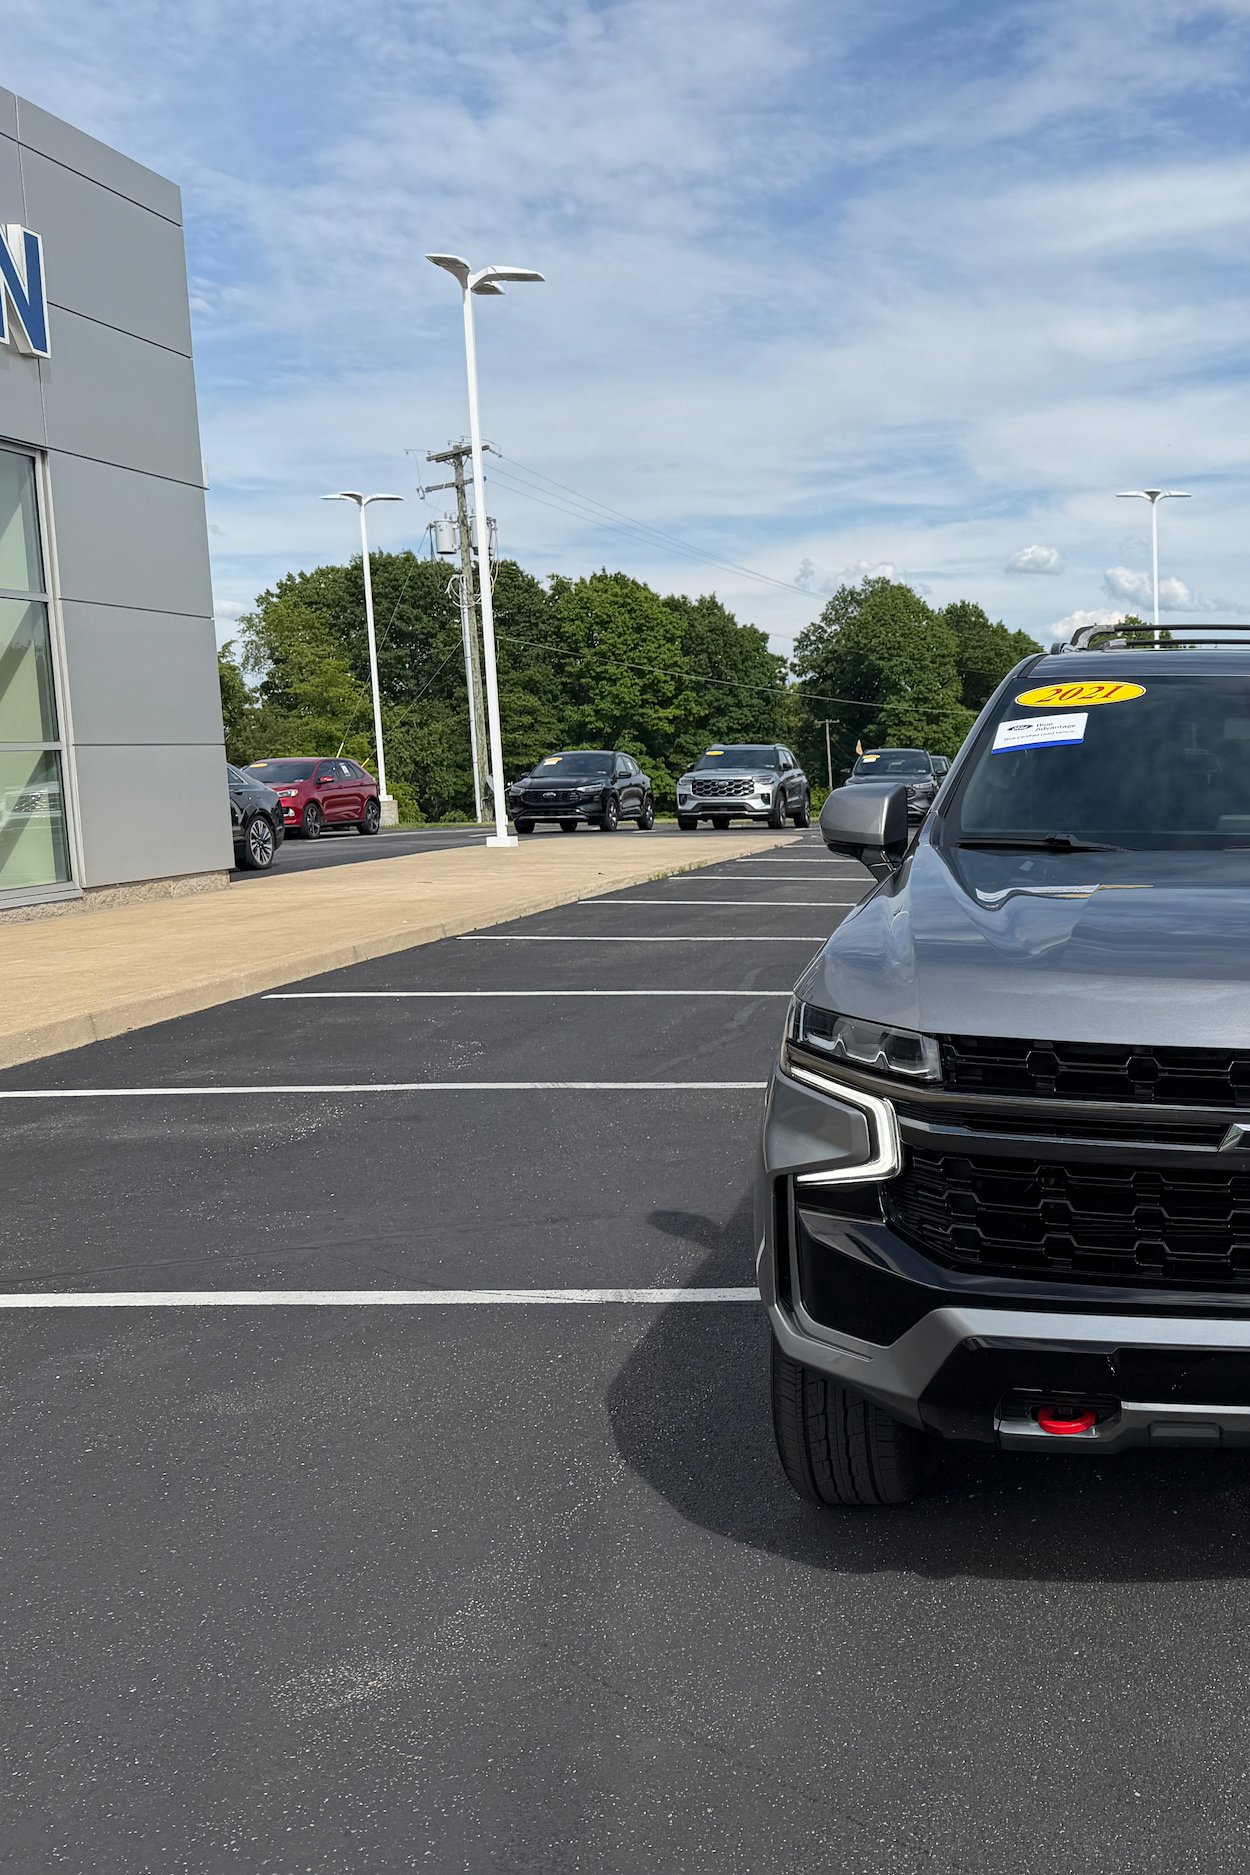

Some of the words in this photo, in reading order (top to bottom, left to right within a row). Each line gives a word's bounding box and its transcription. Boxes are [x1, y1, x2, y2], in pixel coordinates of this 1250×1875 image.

[0, 223, 51, 359] N
[1036, 685, 1124, 703] 2021
[1035, 724, 1077, 732] Advantage
